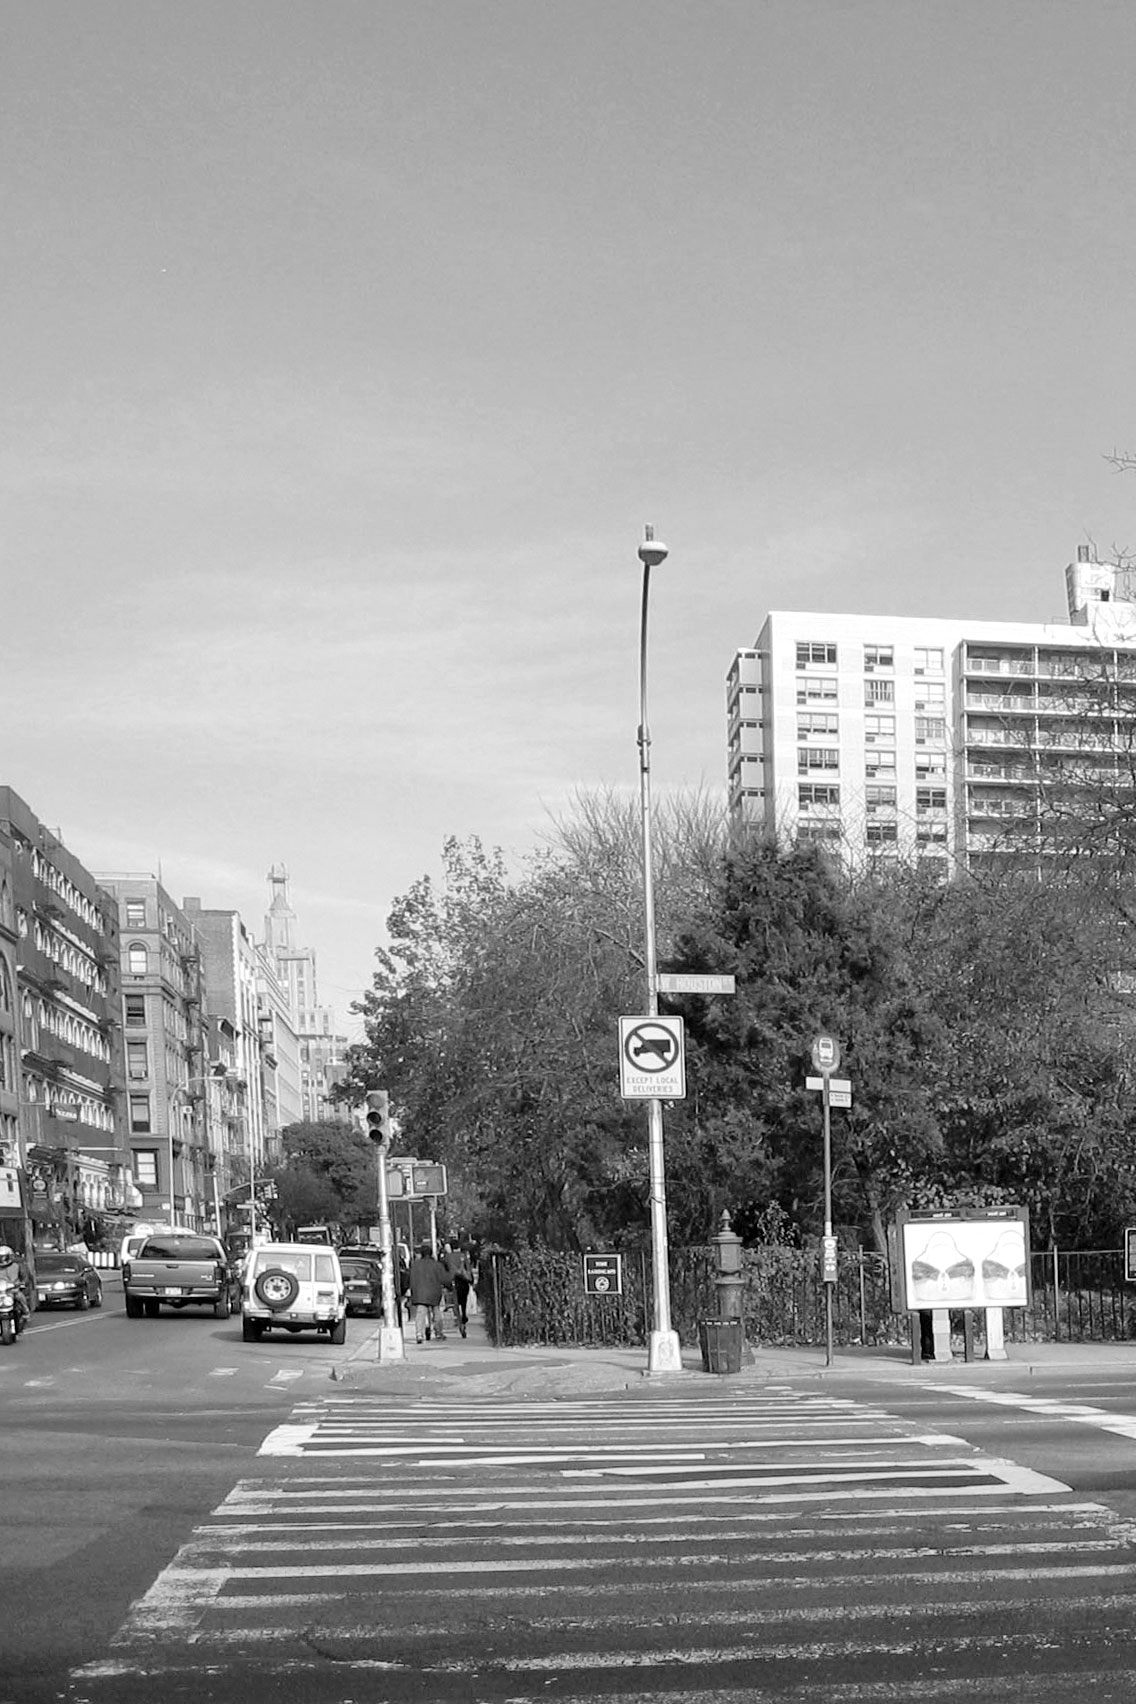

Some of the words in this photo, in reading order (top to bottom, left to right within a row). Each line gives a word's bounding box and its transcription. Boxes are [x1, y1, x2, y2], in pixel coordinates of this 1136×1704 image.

[676, 977, 722, 991] HOUSTON
[626, 1076, 653, 1084] EXCEPT
[656, 1076, 679, 1085] LOCAL
[632, 1085, 674, 1093] DELIVERIES
